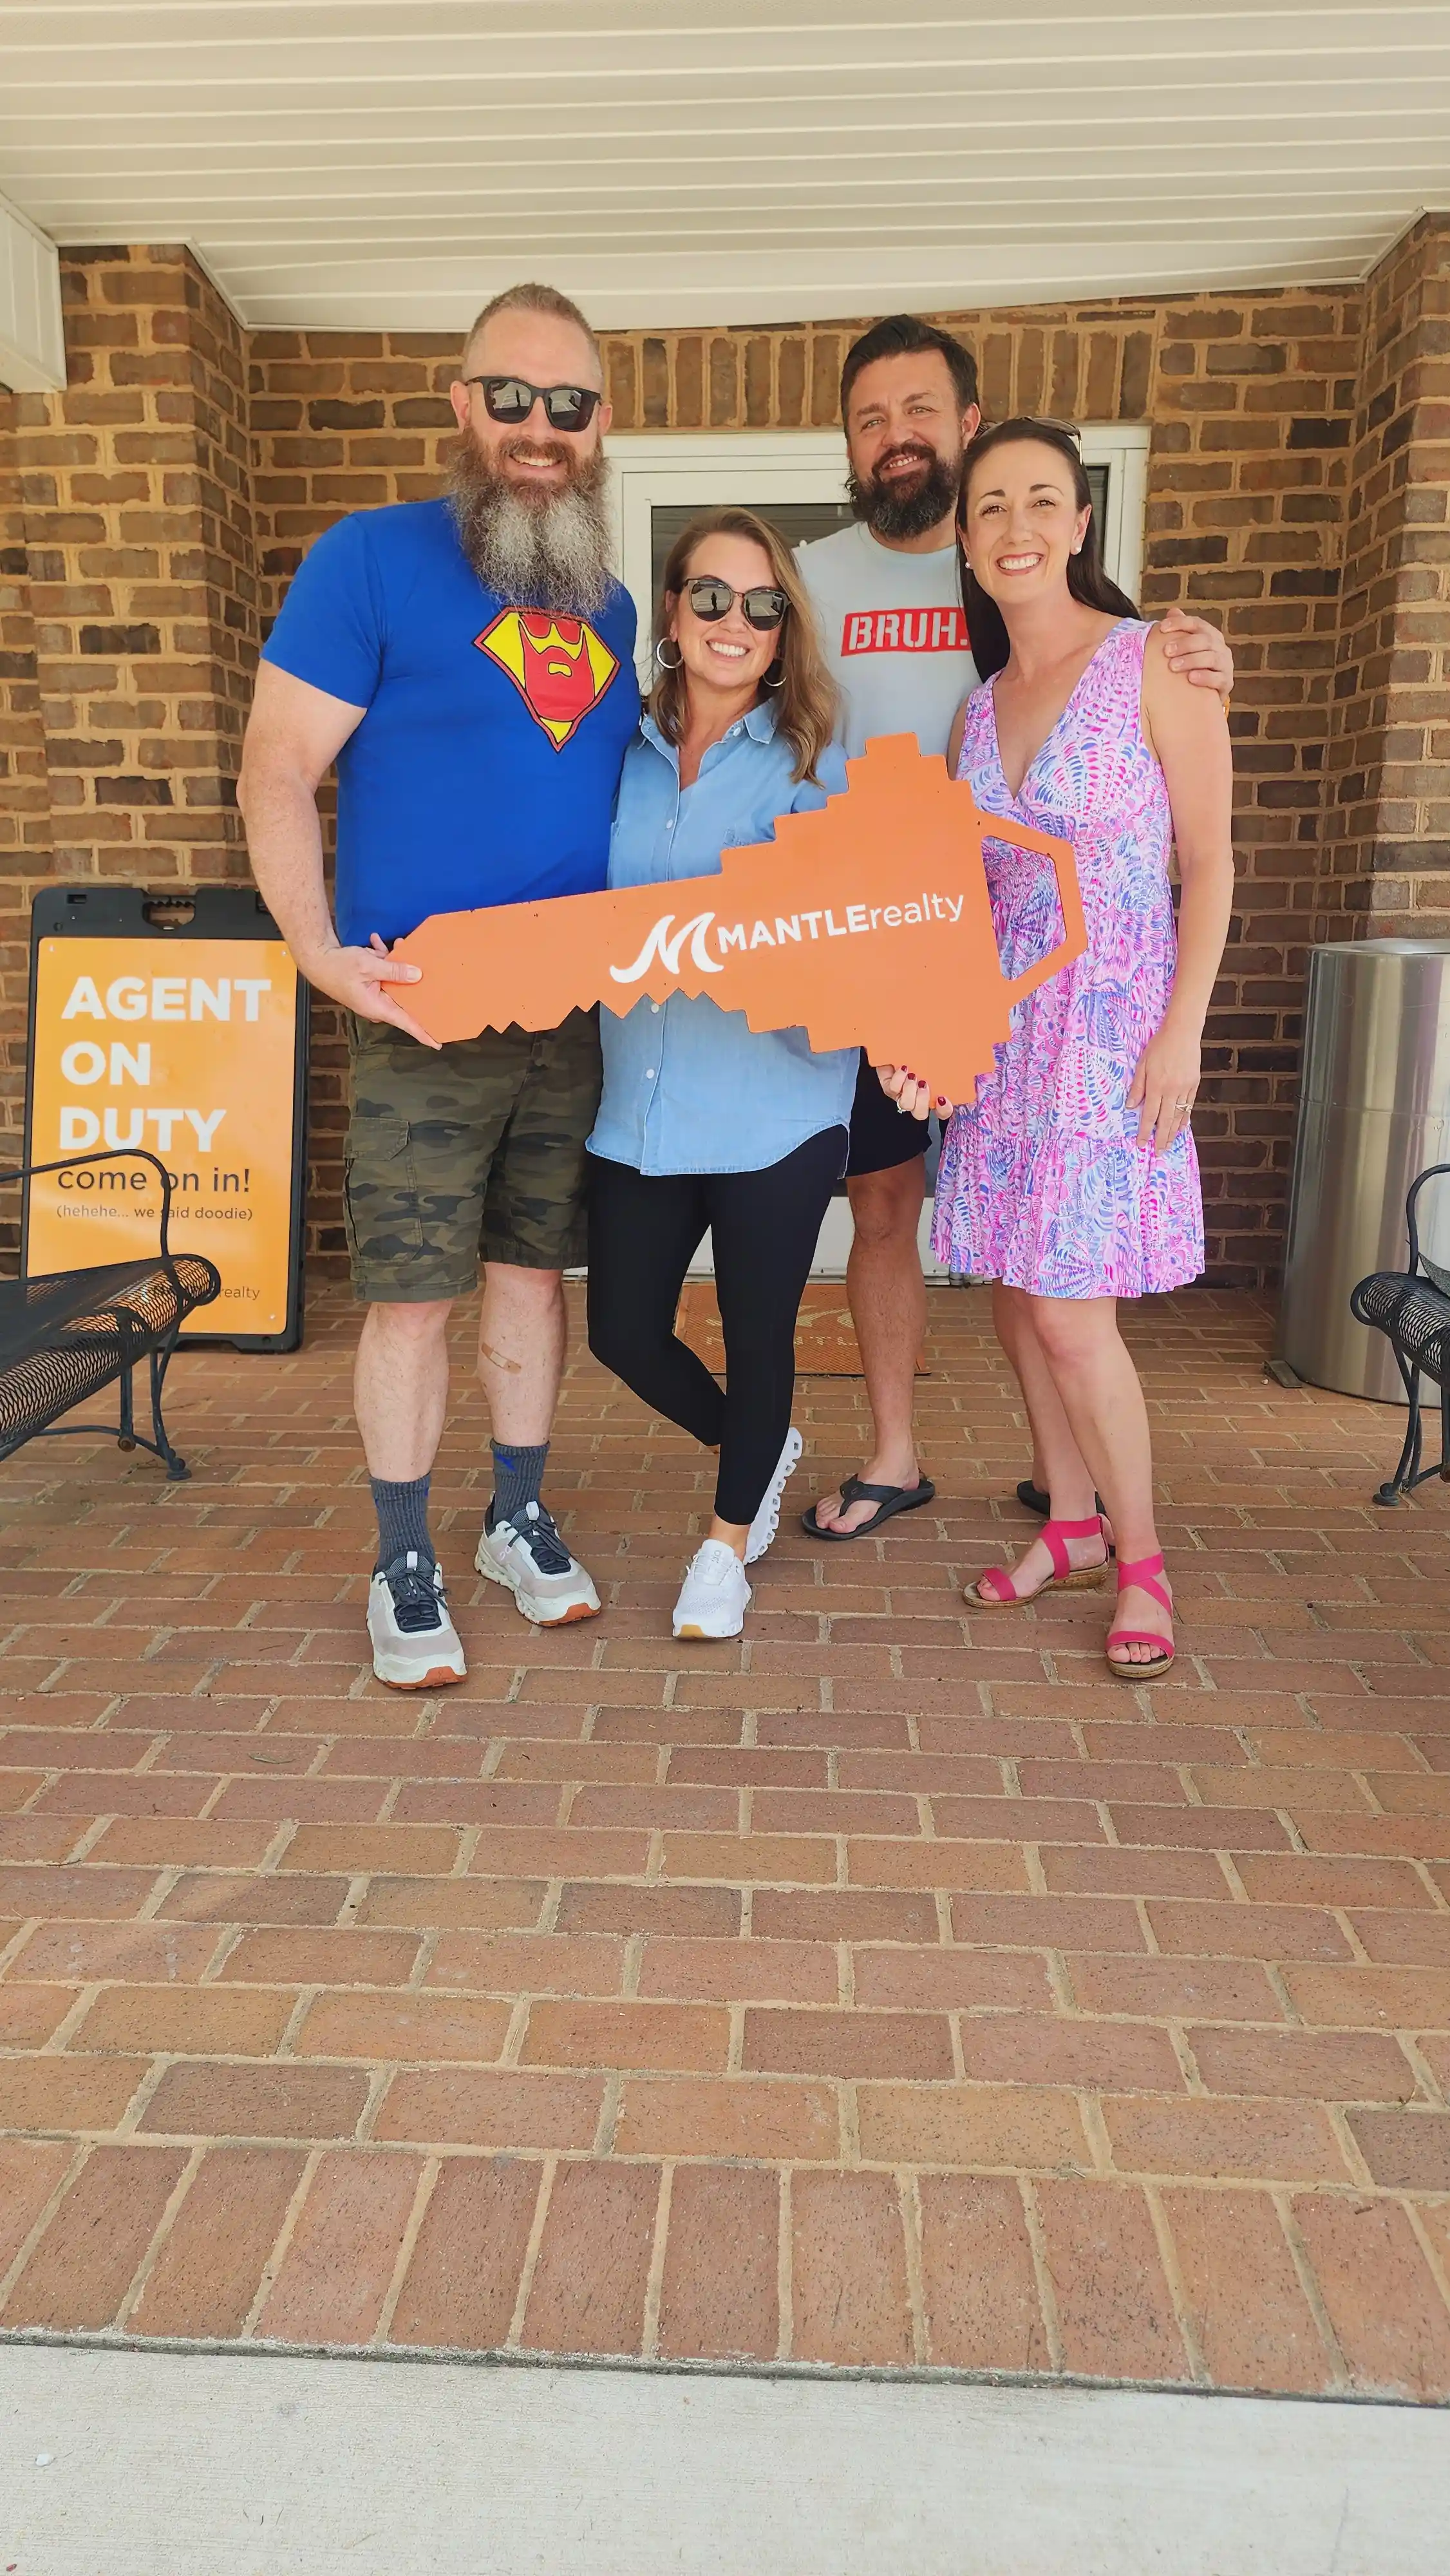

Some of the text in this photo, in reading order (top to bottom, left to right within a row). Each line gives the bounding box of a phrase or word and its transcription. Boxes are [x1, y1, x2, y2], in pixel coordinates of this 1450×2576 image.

[848, 612, 968, 650] BRUH.
[61, 976, 272, 1022] AGENT
[60, 1040, 151, 1086] ON
[59, 1106, 227, 1153] DUTY
[57, 1166, 250, 1193] come on in!
[134, 1208, 155, 1218] we
[160, 1206, 189, 1219] aid
[194, 1207, 254, 1221] doodie)
